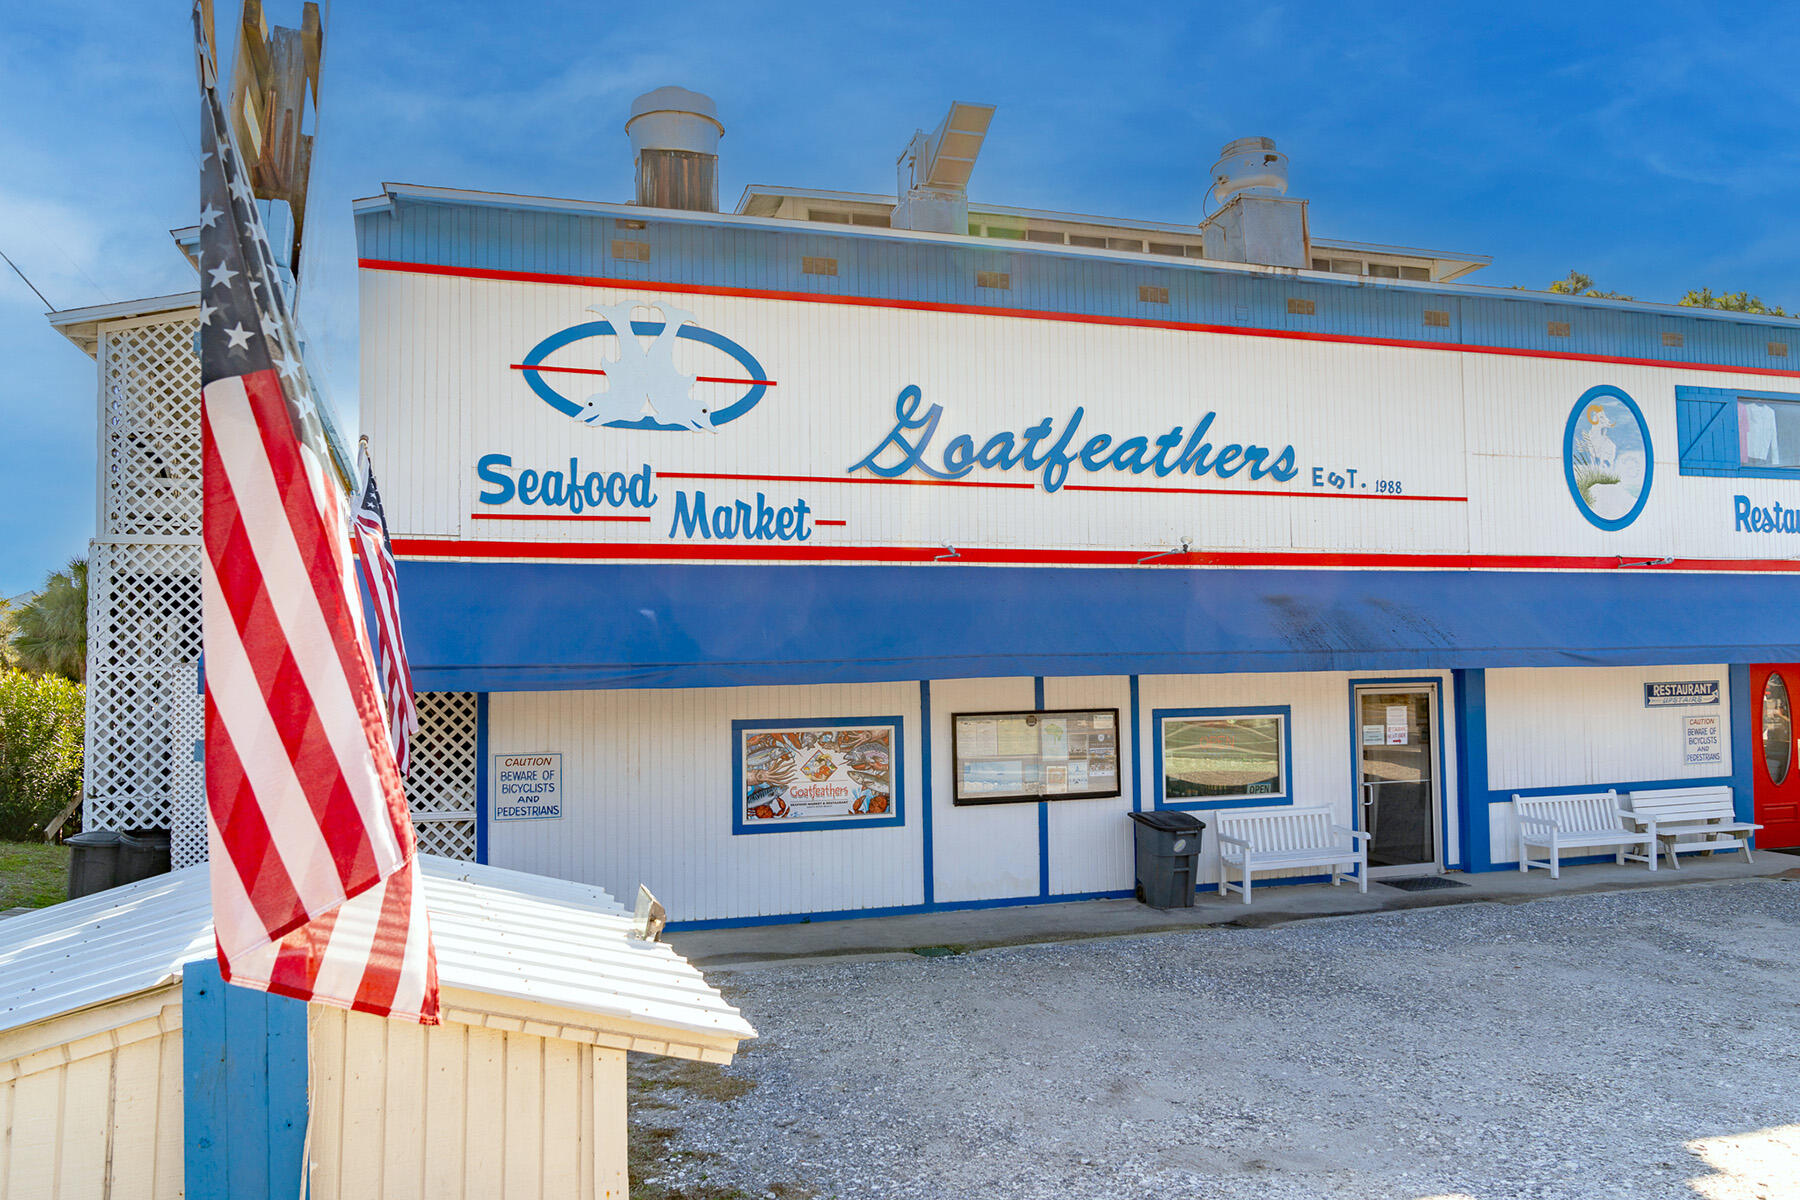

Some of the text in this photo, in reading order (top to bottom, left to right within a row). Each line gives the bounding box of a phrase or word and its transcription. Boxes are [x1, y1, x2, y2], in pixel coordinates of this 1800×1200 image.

[848, 384, 1299, 493] Goatfeathers
[477, 453, 658, 514] Seafood
[1375, 479, 1402, 494] 1988
[668, 490, 812, 541] Market
[1653, 683, 1712, 697] RESTAURANT
[1687, 727, 1717, 736] BEWARE OF
[1200, 735, 1235, 749] OPEN
[504, 757, 552, 767] CAUTION
[1687, 753, 1720, 762] PEDESTRIANS
[500, 769, 554, 782] BEWARE OF
[501, 782, 555, 794] BICYCLISTS
[790, 783, 848, 800] Goatfeathers
[1249, 784, 1270, 794] OPEN
[517, 795, 540, 803] AND
[497, 805, 559, 817] PEDESTRIANS
